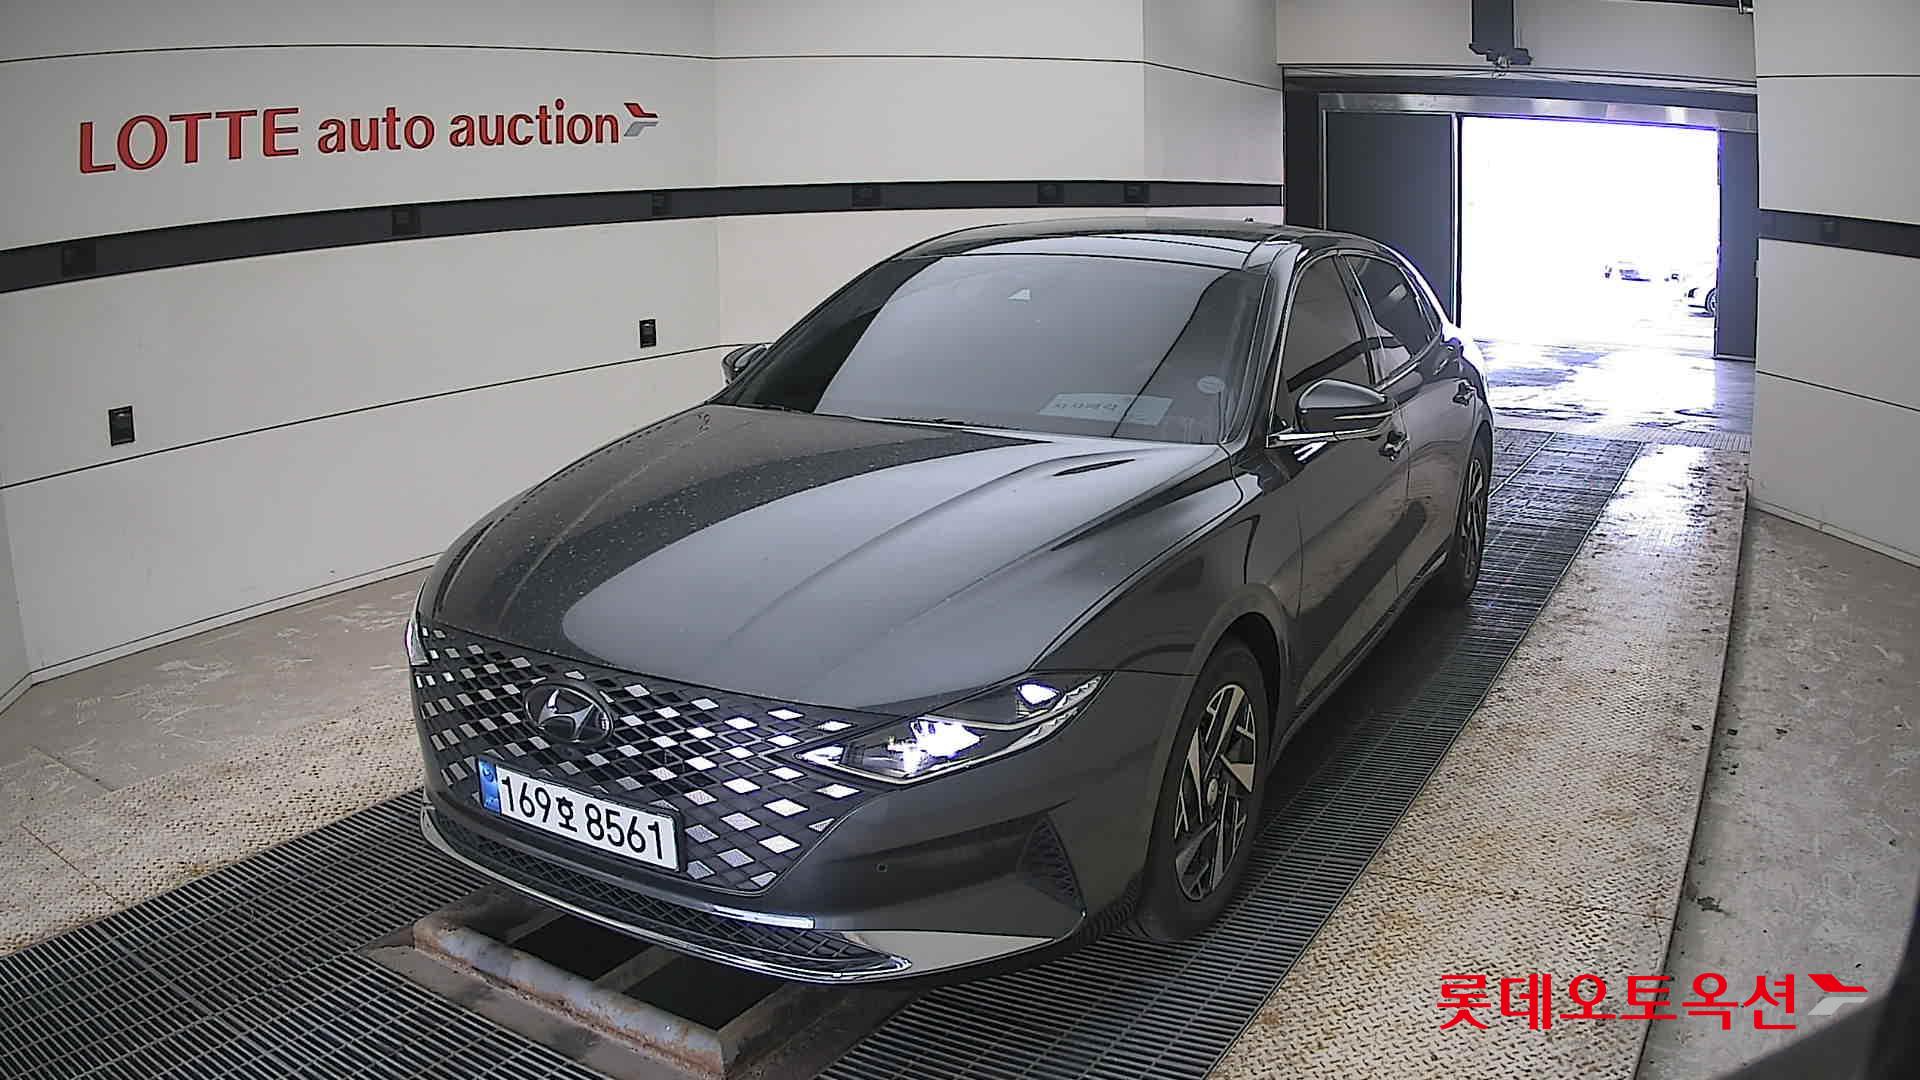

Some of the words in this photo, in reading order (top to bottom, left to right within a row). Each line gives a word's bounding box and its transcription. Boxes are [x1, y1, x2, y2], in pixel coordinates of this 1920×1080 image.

[79, 107, 299, 174] LOTTE
[317, 106, 436, 154] auto
[449, 98, 620, 148] auction
[584, 803, 663, 860] 8561
